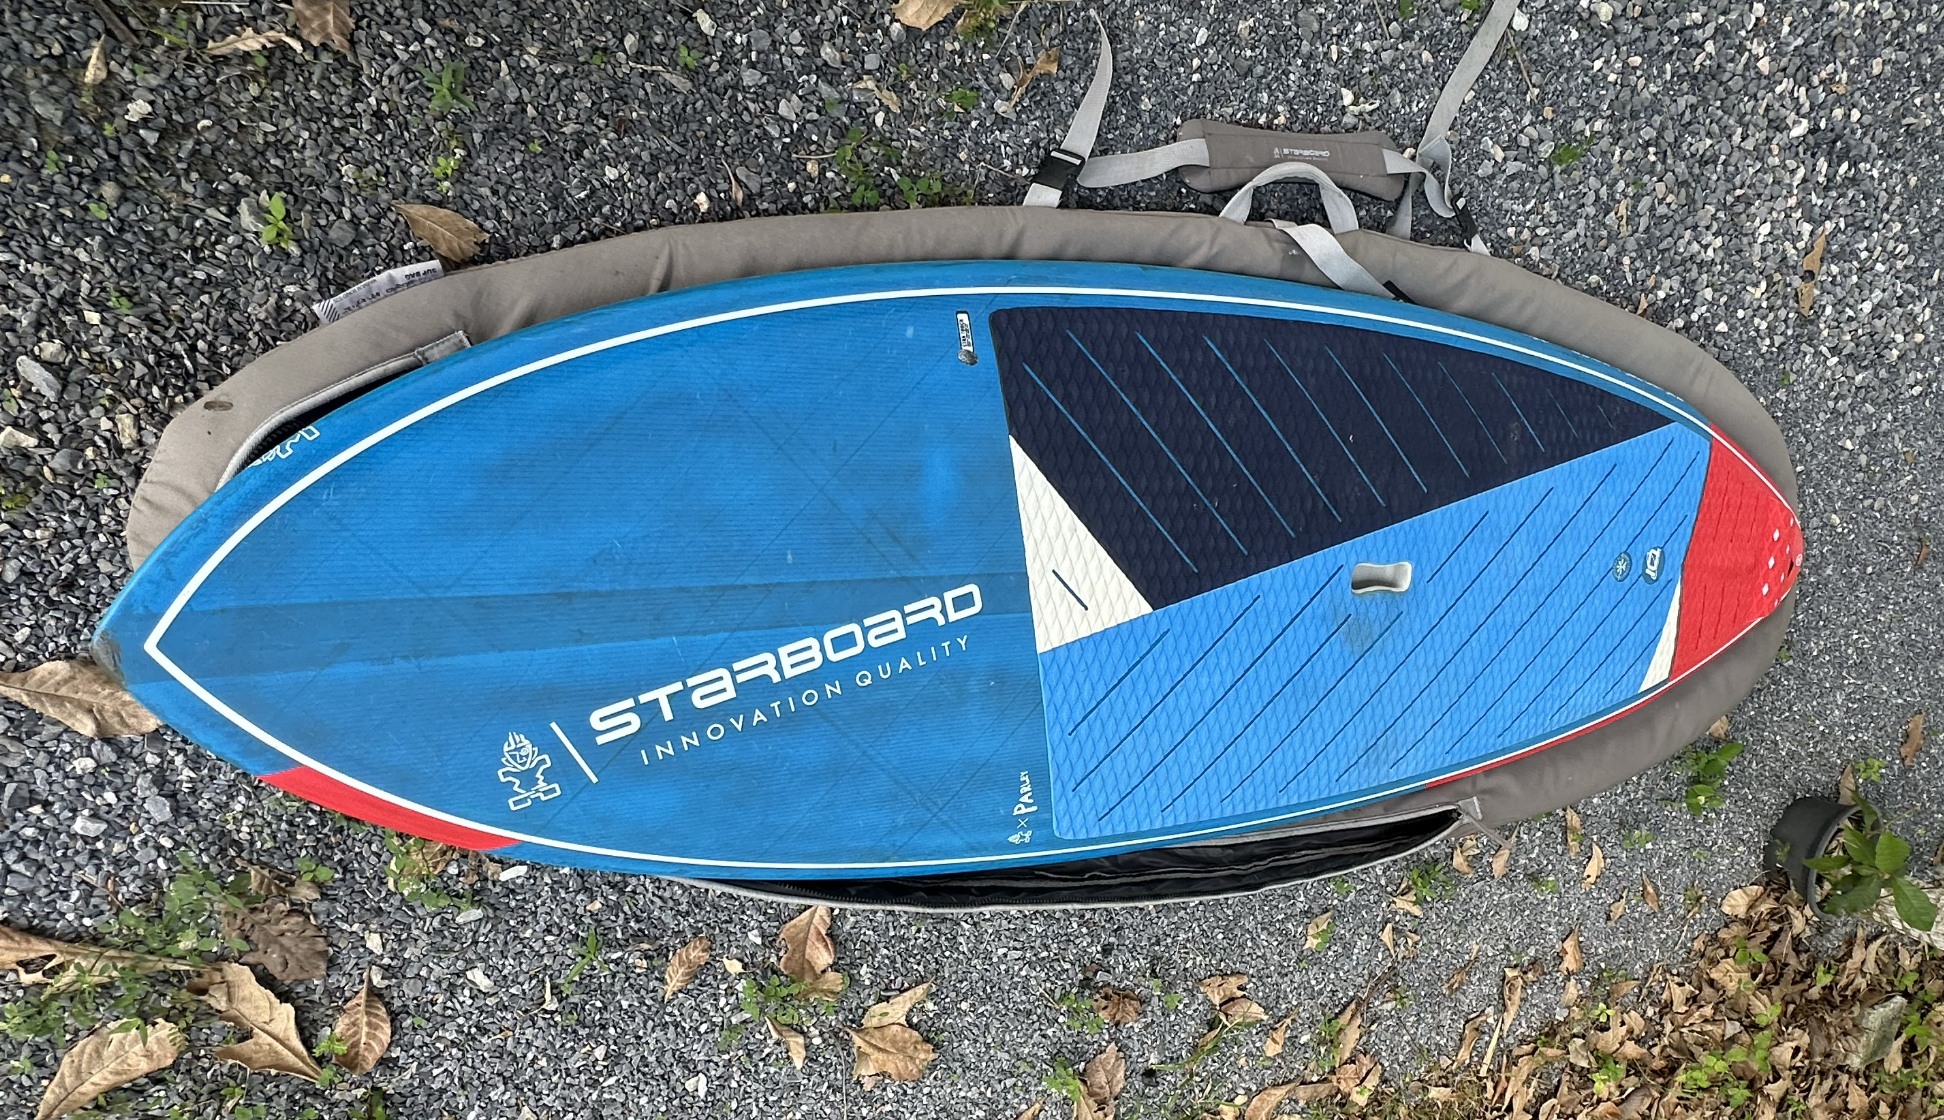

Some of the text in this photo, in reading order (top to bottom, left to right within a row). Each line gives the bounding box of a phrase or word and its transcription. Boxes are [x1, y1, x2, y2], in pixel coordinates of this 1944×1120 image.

[589, 583, 984, 746] STARBOARD
[641, 635, 970, 766] INNOVATION QUALITY
